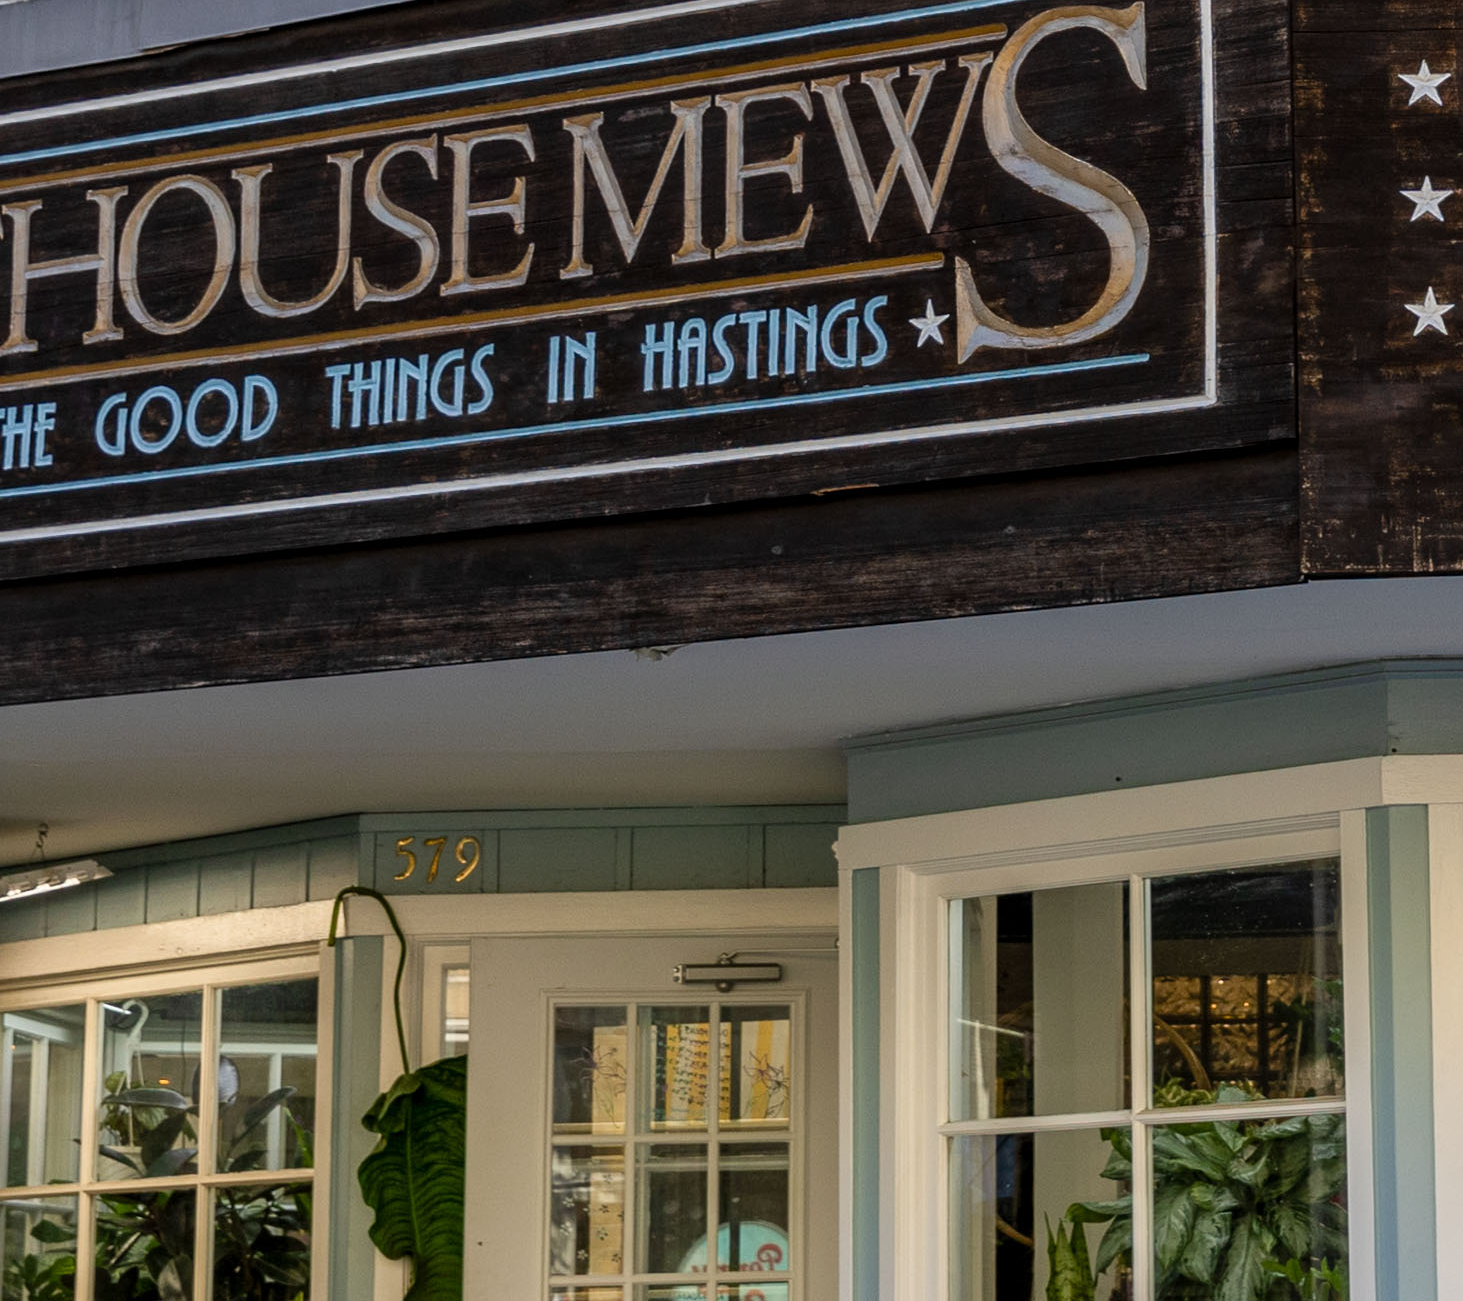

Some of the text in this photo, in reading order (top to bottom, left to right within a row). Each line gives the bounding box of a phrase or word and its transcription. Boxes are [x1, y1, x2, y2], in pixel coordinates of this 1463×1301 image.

[560, 1, 1149, 364] MEWS
[96, 374, 278, 455] GOOD
[325, 343, 494, 430] THINGS
[547, 332, 595, 404] IN
[641, 295, 888, 393] HASTINGS
[393, 835, 481, 884] 579
